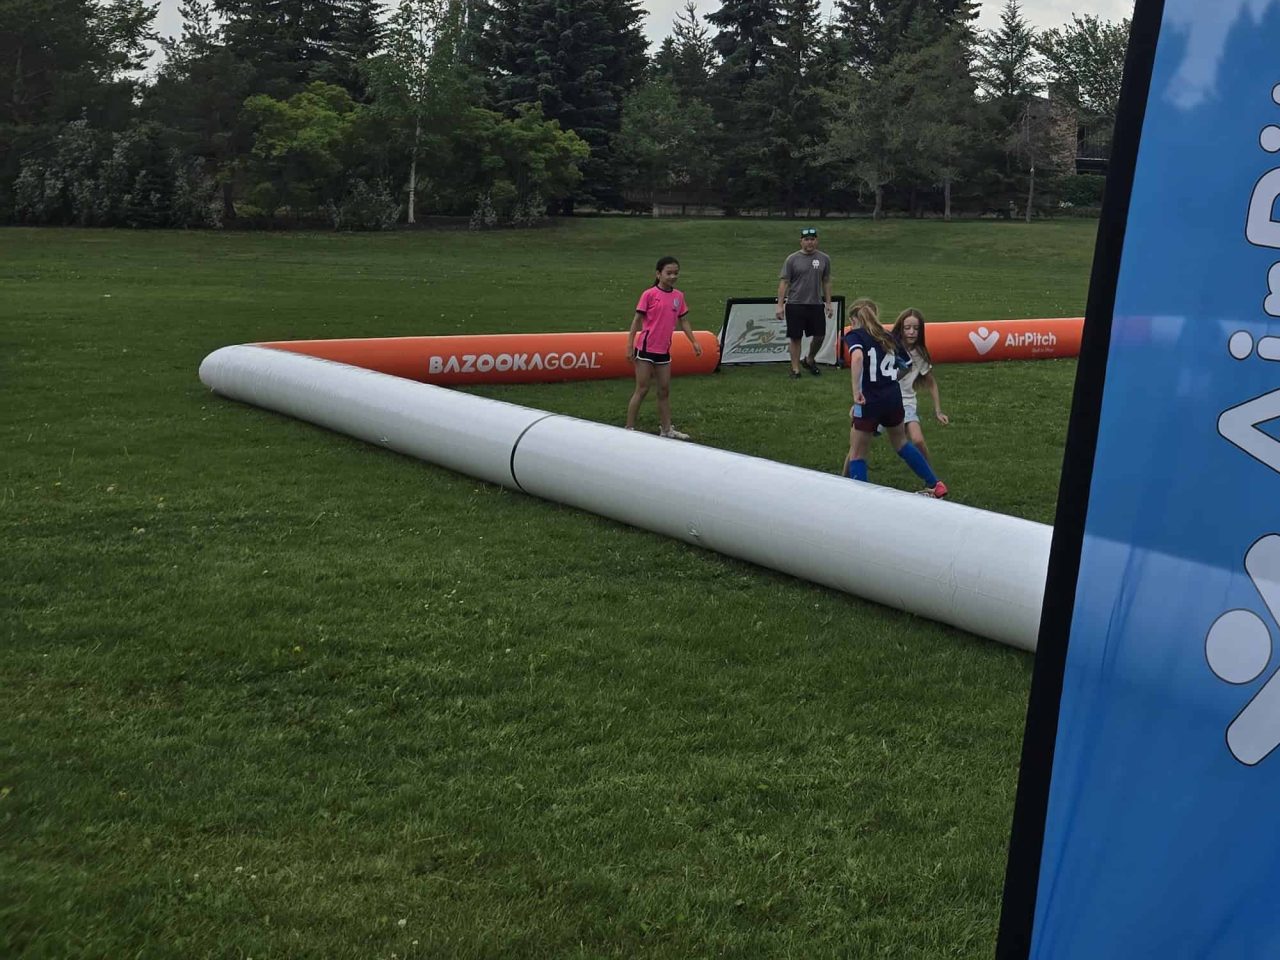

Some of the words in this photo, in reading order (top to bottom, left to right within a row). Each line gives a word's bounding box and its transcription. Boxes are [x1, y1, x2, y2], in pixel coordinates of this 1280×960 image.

[1005, 332, 1057, 347] AirPitch
[428, 352, 602, 374] BAZOOKAGOAL
[868, 347, 898, 382] 14
